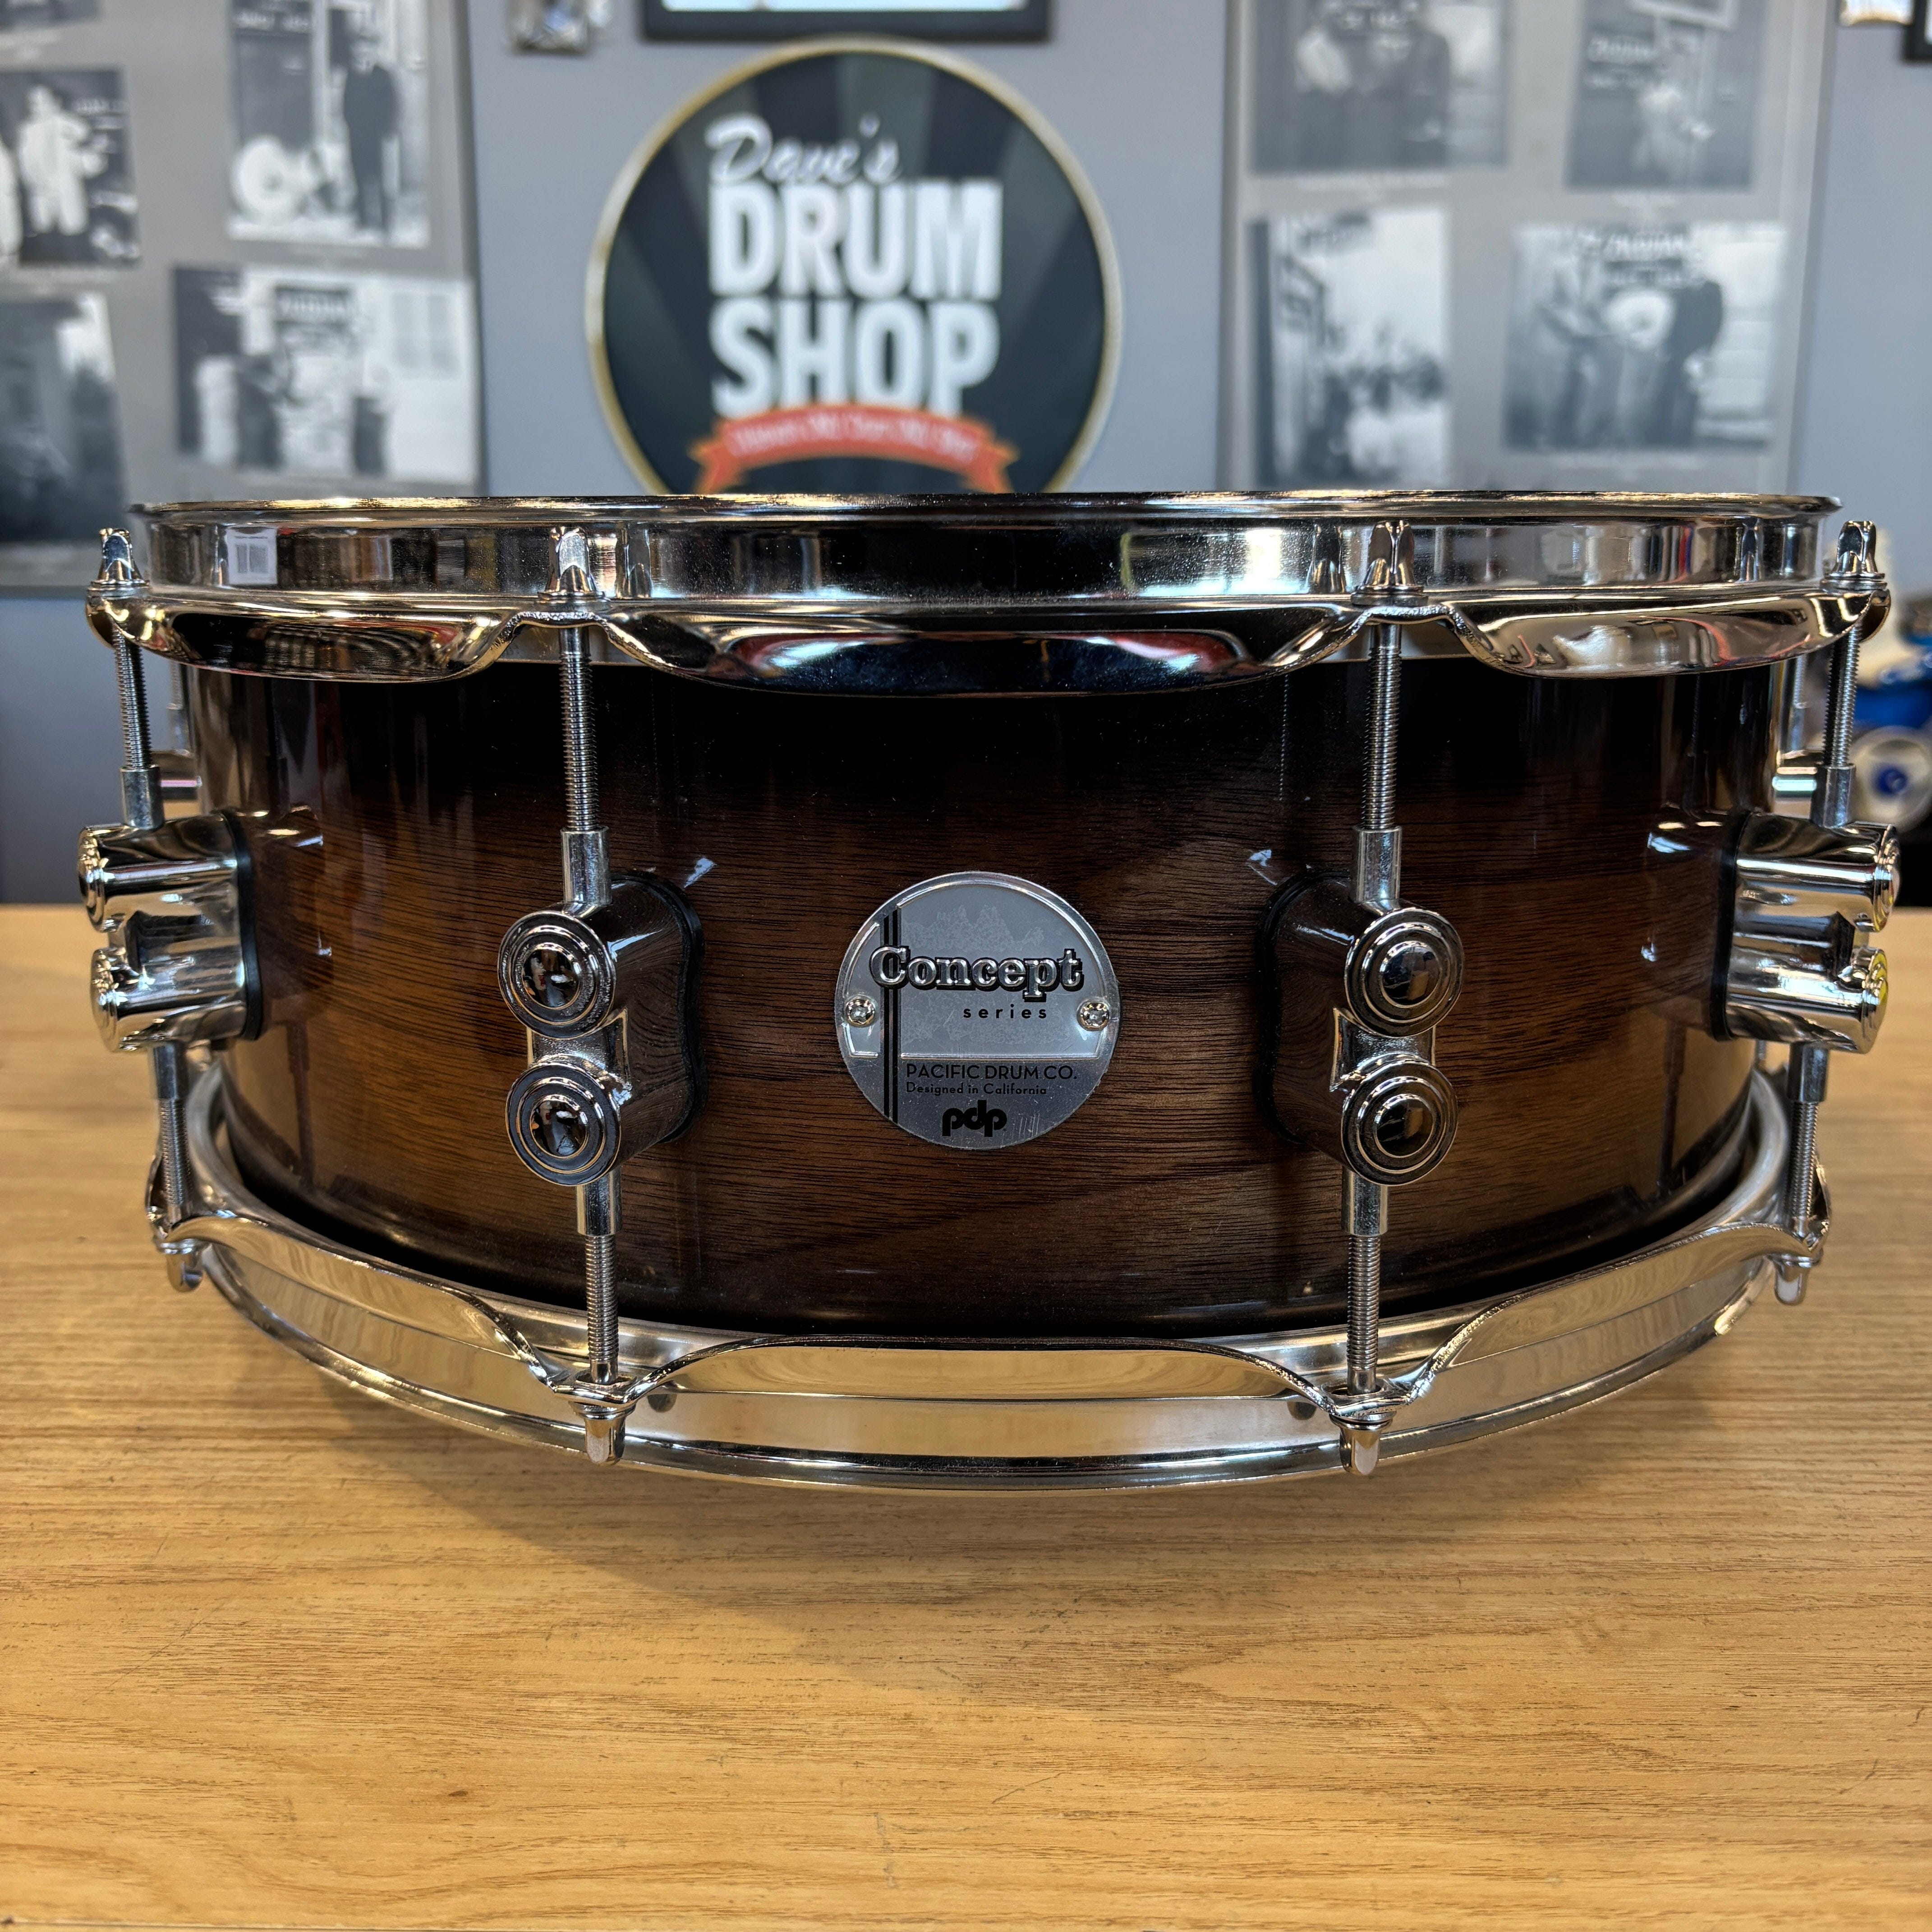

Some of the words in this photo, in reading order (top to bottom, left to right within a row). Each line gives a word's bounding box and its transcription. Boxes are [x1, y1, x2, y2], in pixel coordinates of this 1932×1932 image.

[704, 113, 901, 182] Dave's
[709, 179, 1003, 298] DRUM
[709, 299, 1000, 417] SHOP
[869, 945, 1085, 1003] Concept
[963, 1003, 1047, 1019] series
[906, 1063, 980, 1079] PACIFIC
[985, 1065, 1038, 1080] DRUM
[1044, 1065, 1077, 1080] CO.
[906, 1082, 964, 1096] Designed
[968, 1085, 979, 1094] in
[983, 1083, 1047, 1095] California
[942, 1099, 1007, 1137] pdp
